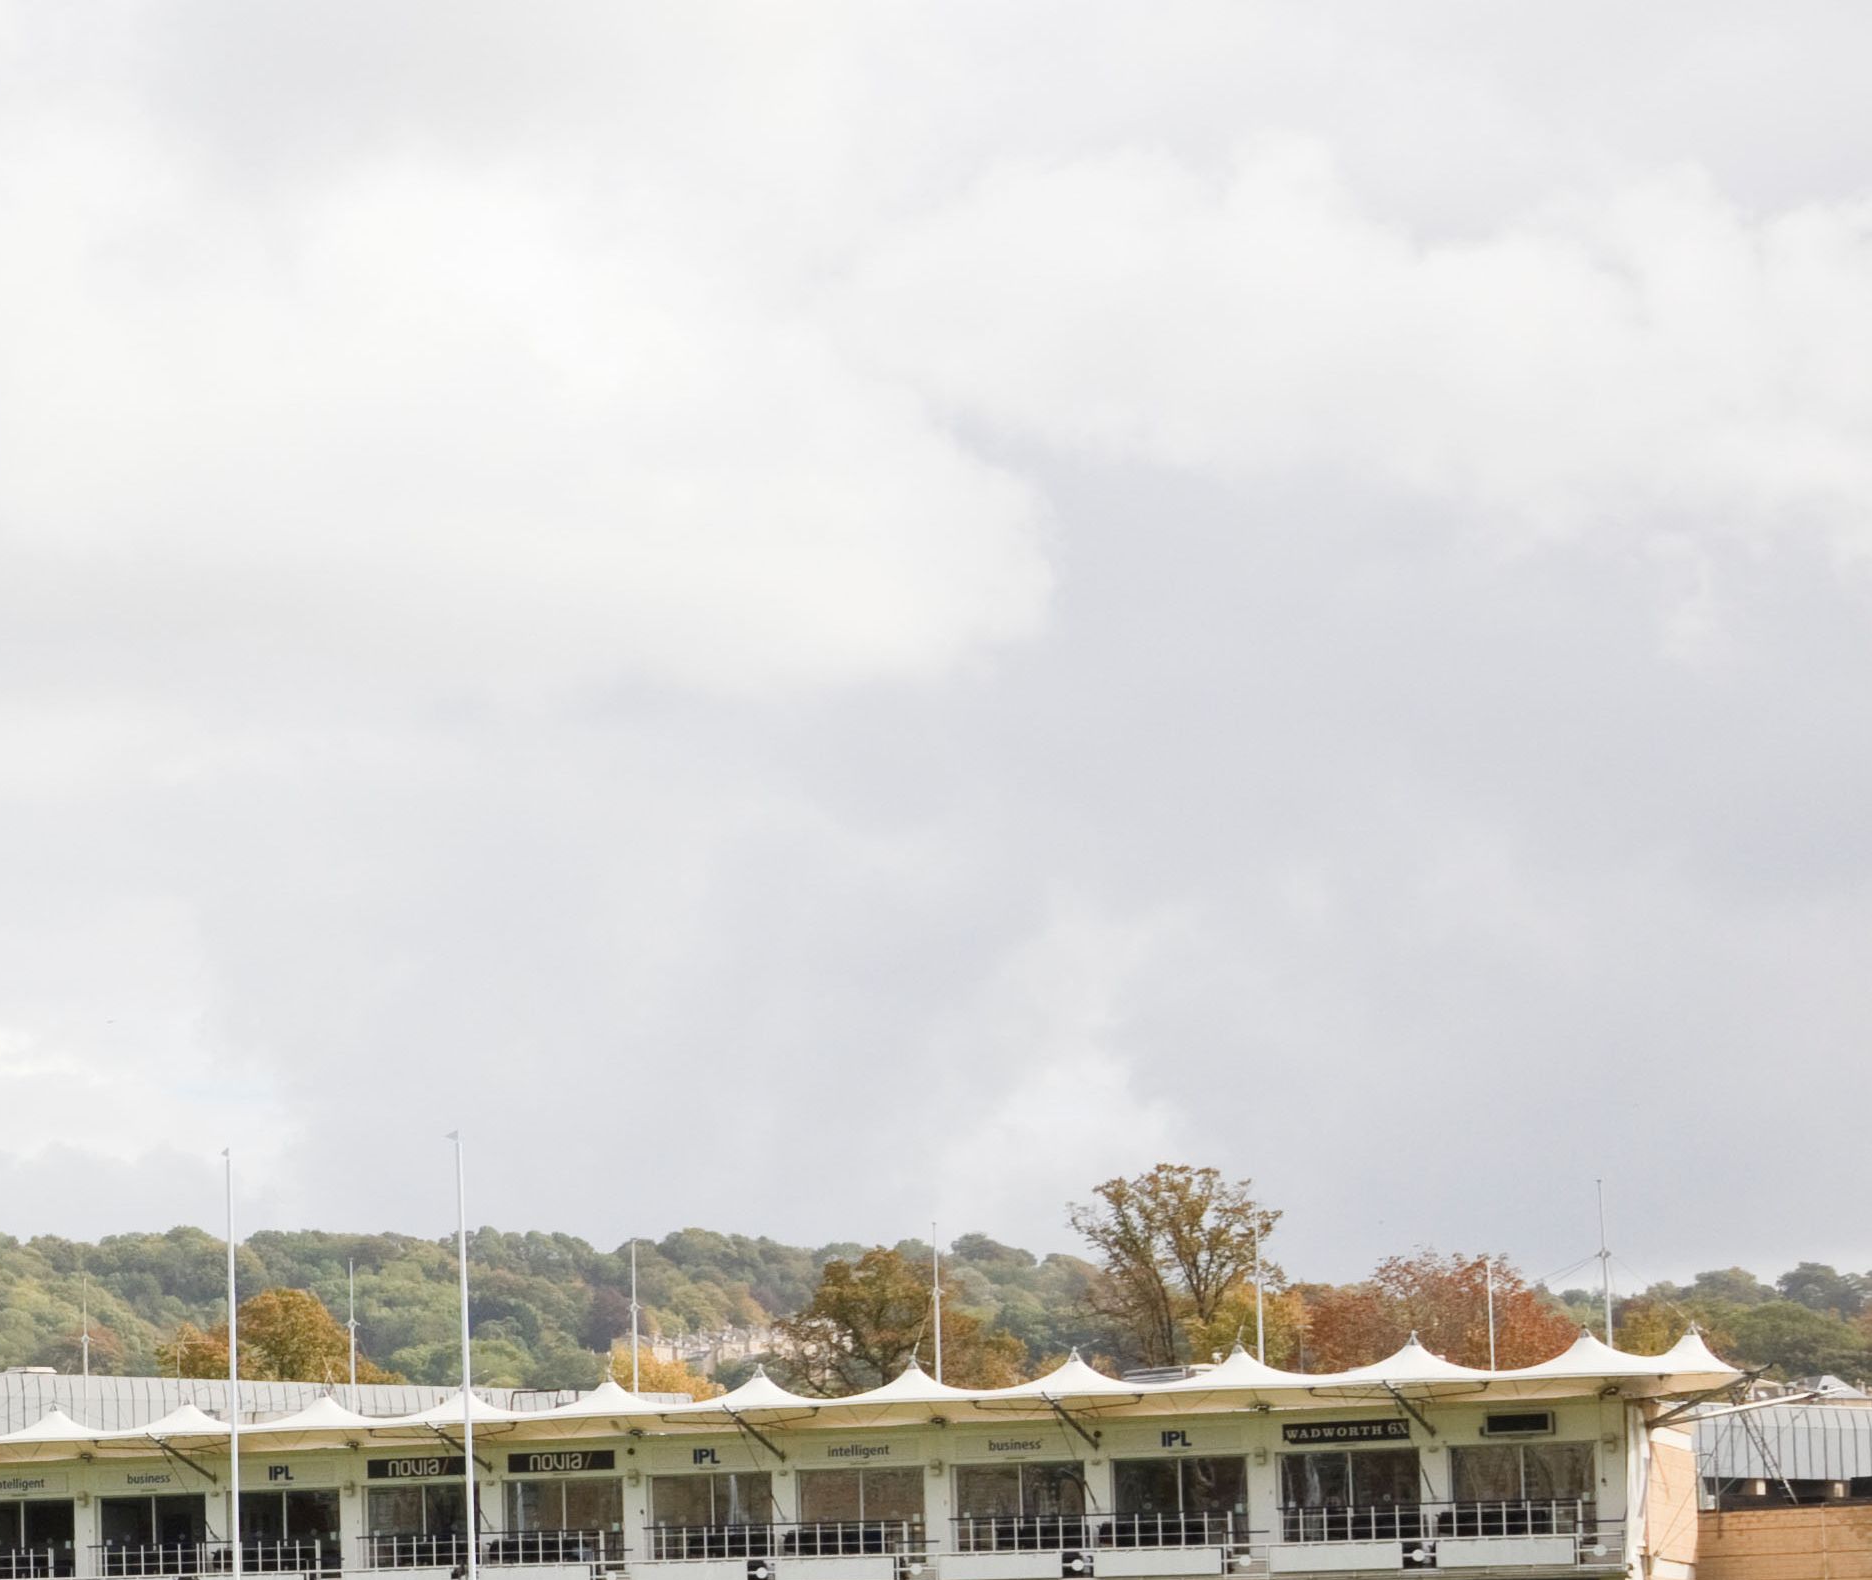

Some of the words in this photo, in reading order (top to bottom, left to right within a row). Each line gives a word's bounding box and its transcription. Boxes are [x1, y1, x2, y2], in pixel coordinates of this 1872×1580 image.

[1161, 1431, 1192, 1447] IPL
[1285, 1425, 1382, 1440] WADWORTH
[1387, 1422, 1408, 1435] 6X
[827, 1445, 890, 1459] intelligent
[988, 1438, 1041, 1452] business
[693, 1448, 721, 1465] IPL
[127, 1473, 171, 1484] business
[268, 1465, 294, 1481] IPL
